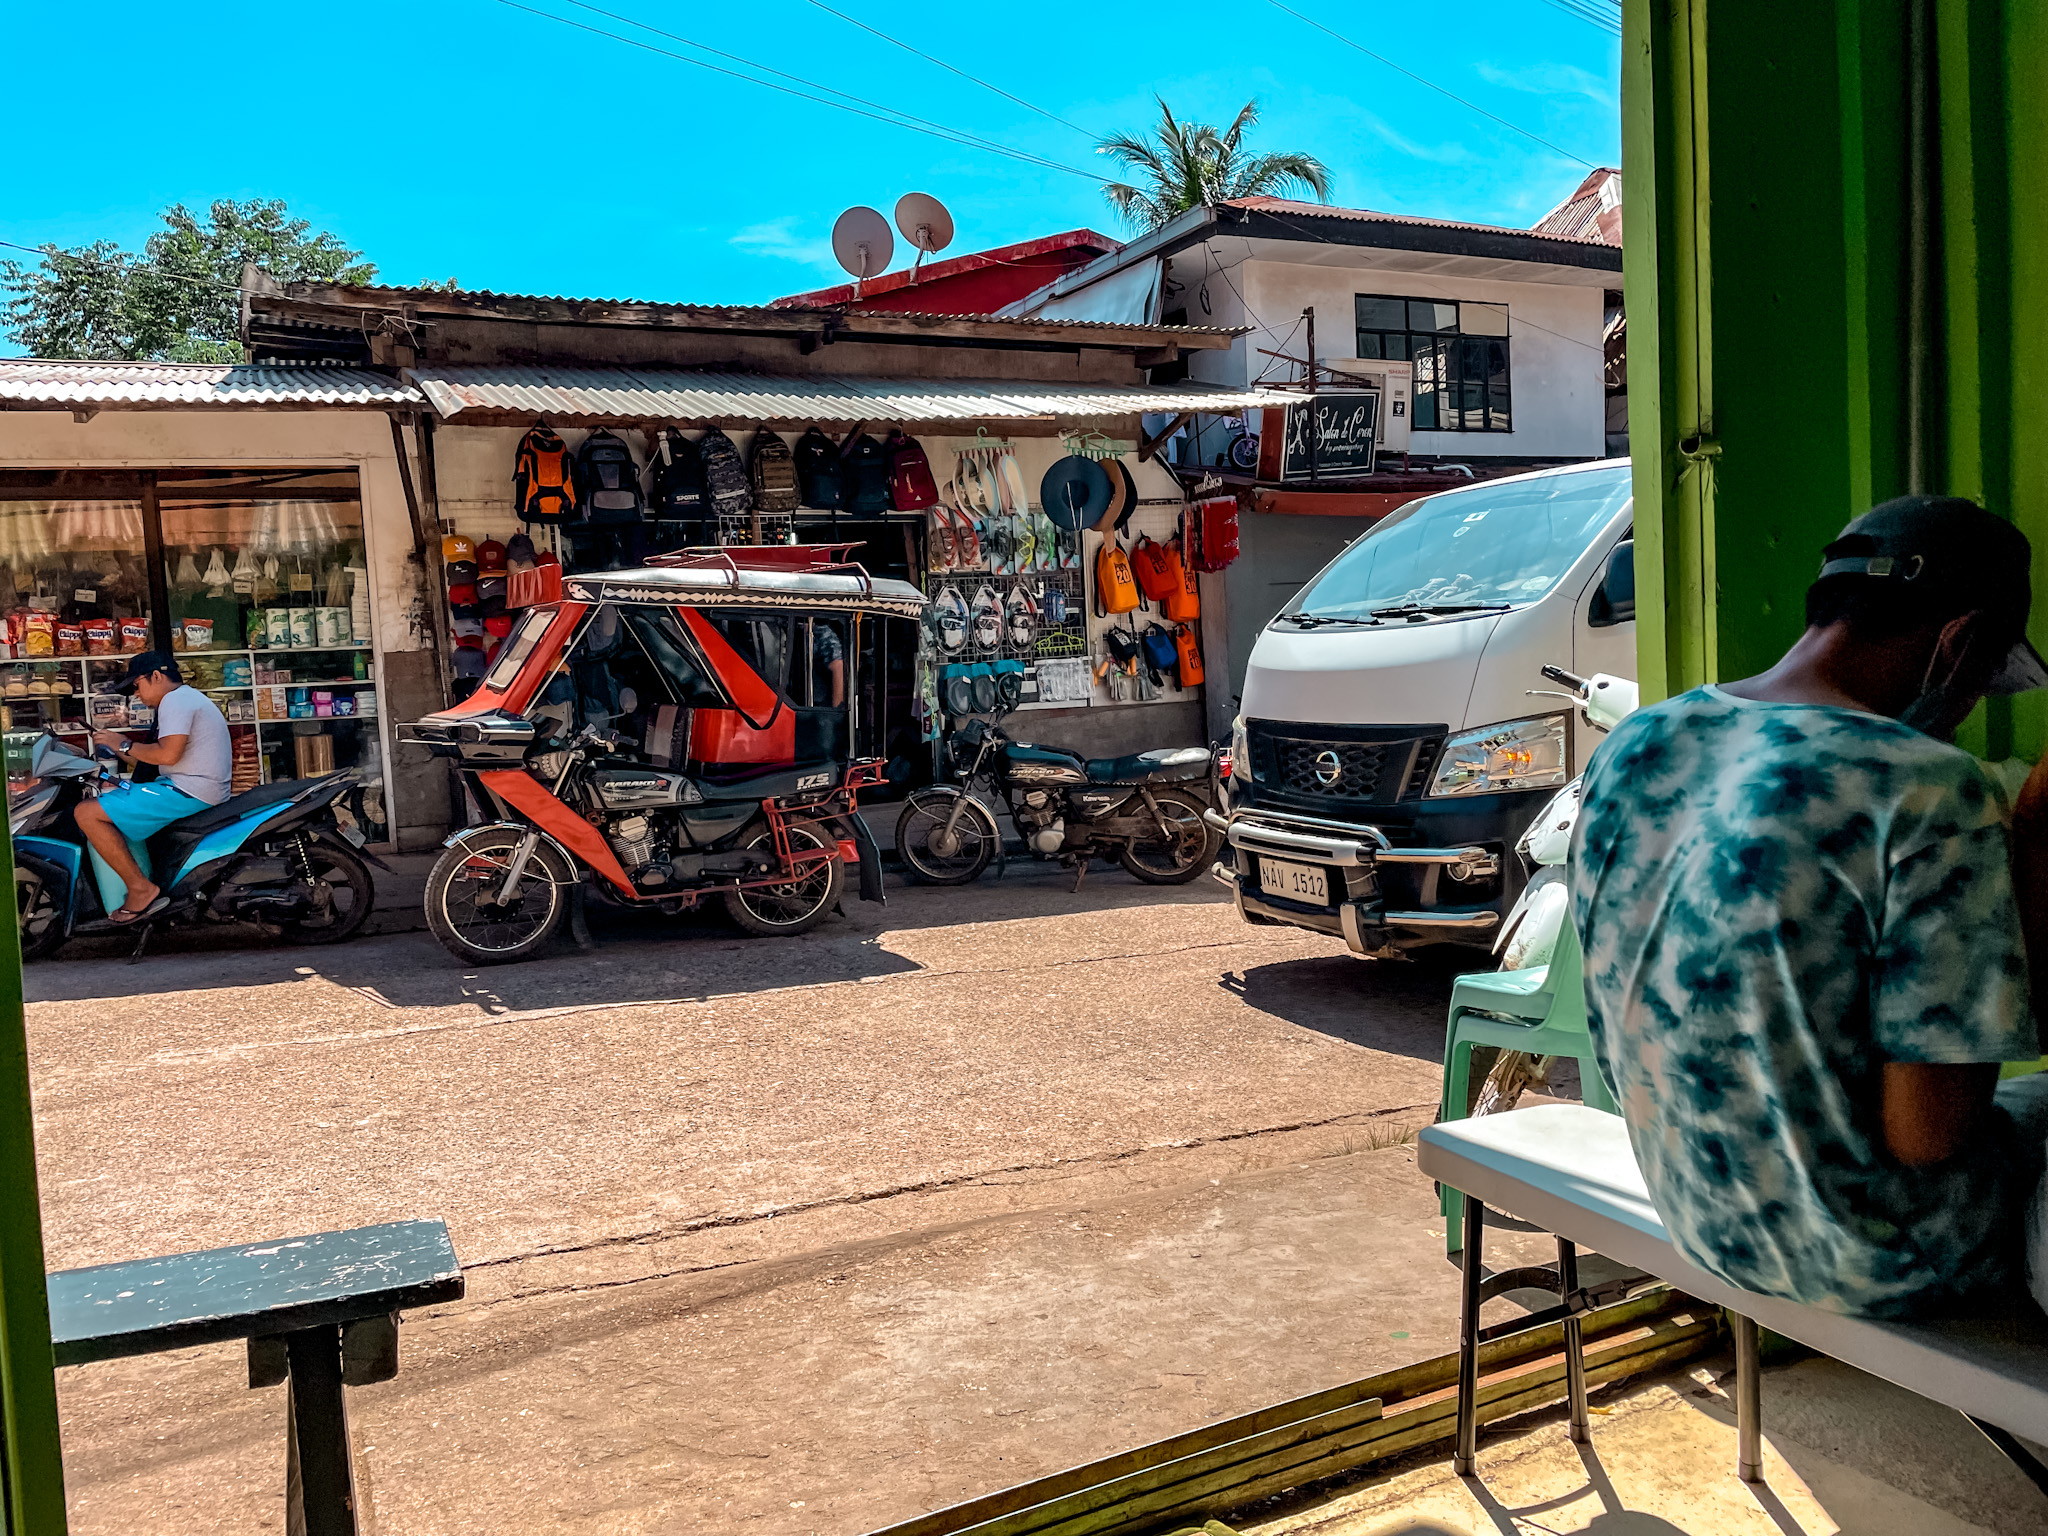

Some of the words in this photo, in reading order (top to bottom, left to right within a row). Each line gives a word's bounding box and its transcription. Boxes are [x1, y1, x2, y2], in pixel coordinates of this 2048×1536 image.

[1316, 405, 1340, 450] Salon
[1116, 570, 1131, 584] 20
[1185, 580, 1197, 593] 30
[87, 629, 112, 639] Chippy
[604, 780, 656, 789] BARAKO
[797, 773, 829, 787] 175
[1262, 866, 1284, 889] NAV
[1293, 872, 1325, 898] 1512
